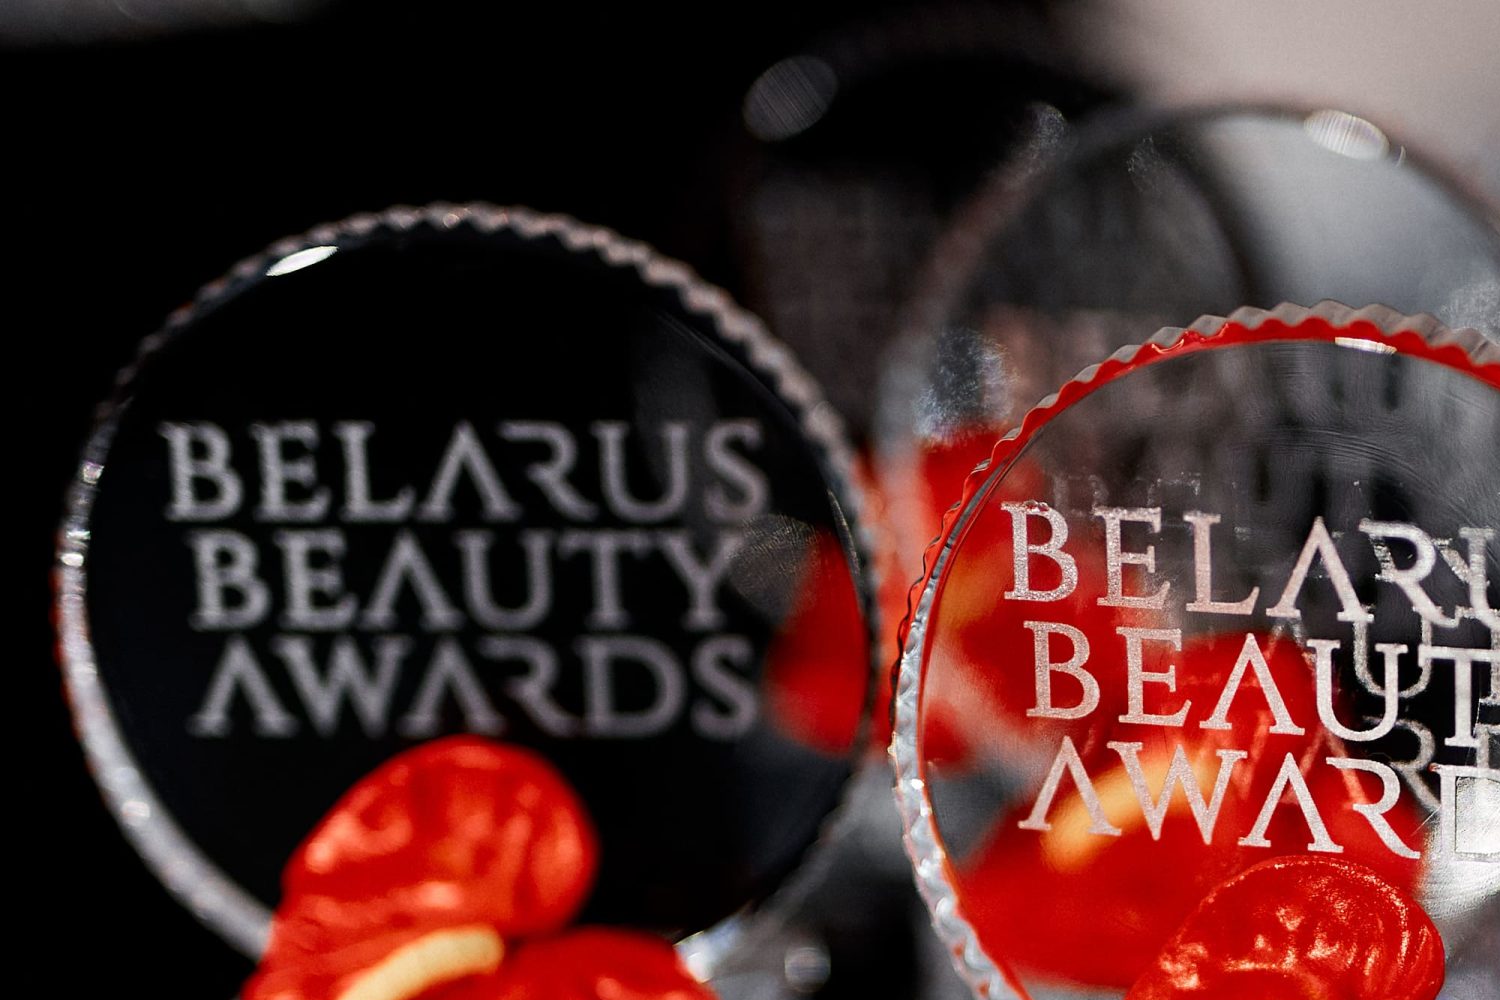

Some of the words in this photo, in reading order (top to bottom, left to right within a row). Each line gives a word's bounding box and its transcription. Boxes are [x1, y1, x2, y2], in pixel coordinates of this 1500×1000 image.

[160, 420, 771, 523] BELARUS
[189, 530, 745, 633] BEAUTY
[189, 635, 761, 739] AWARDS
